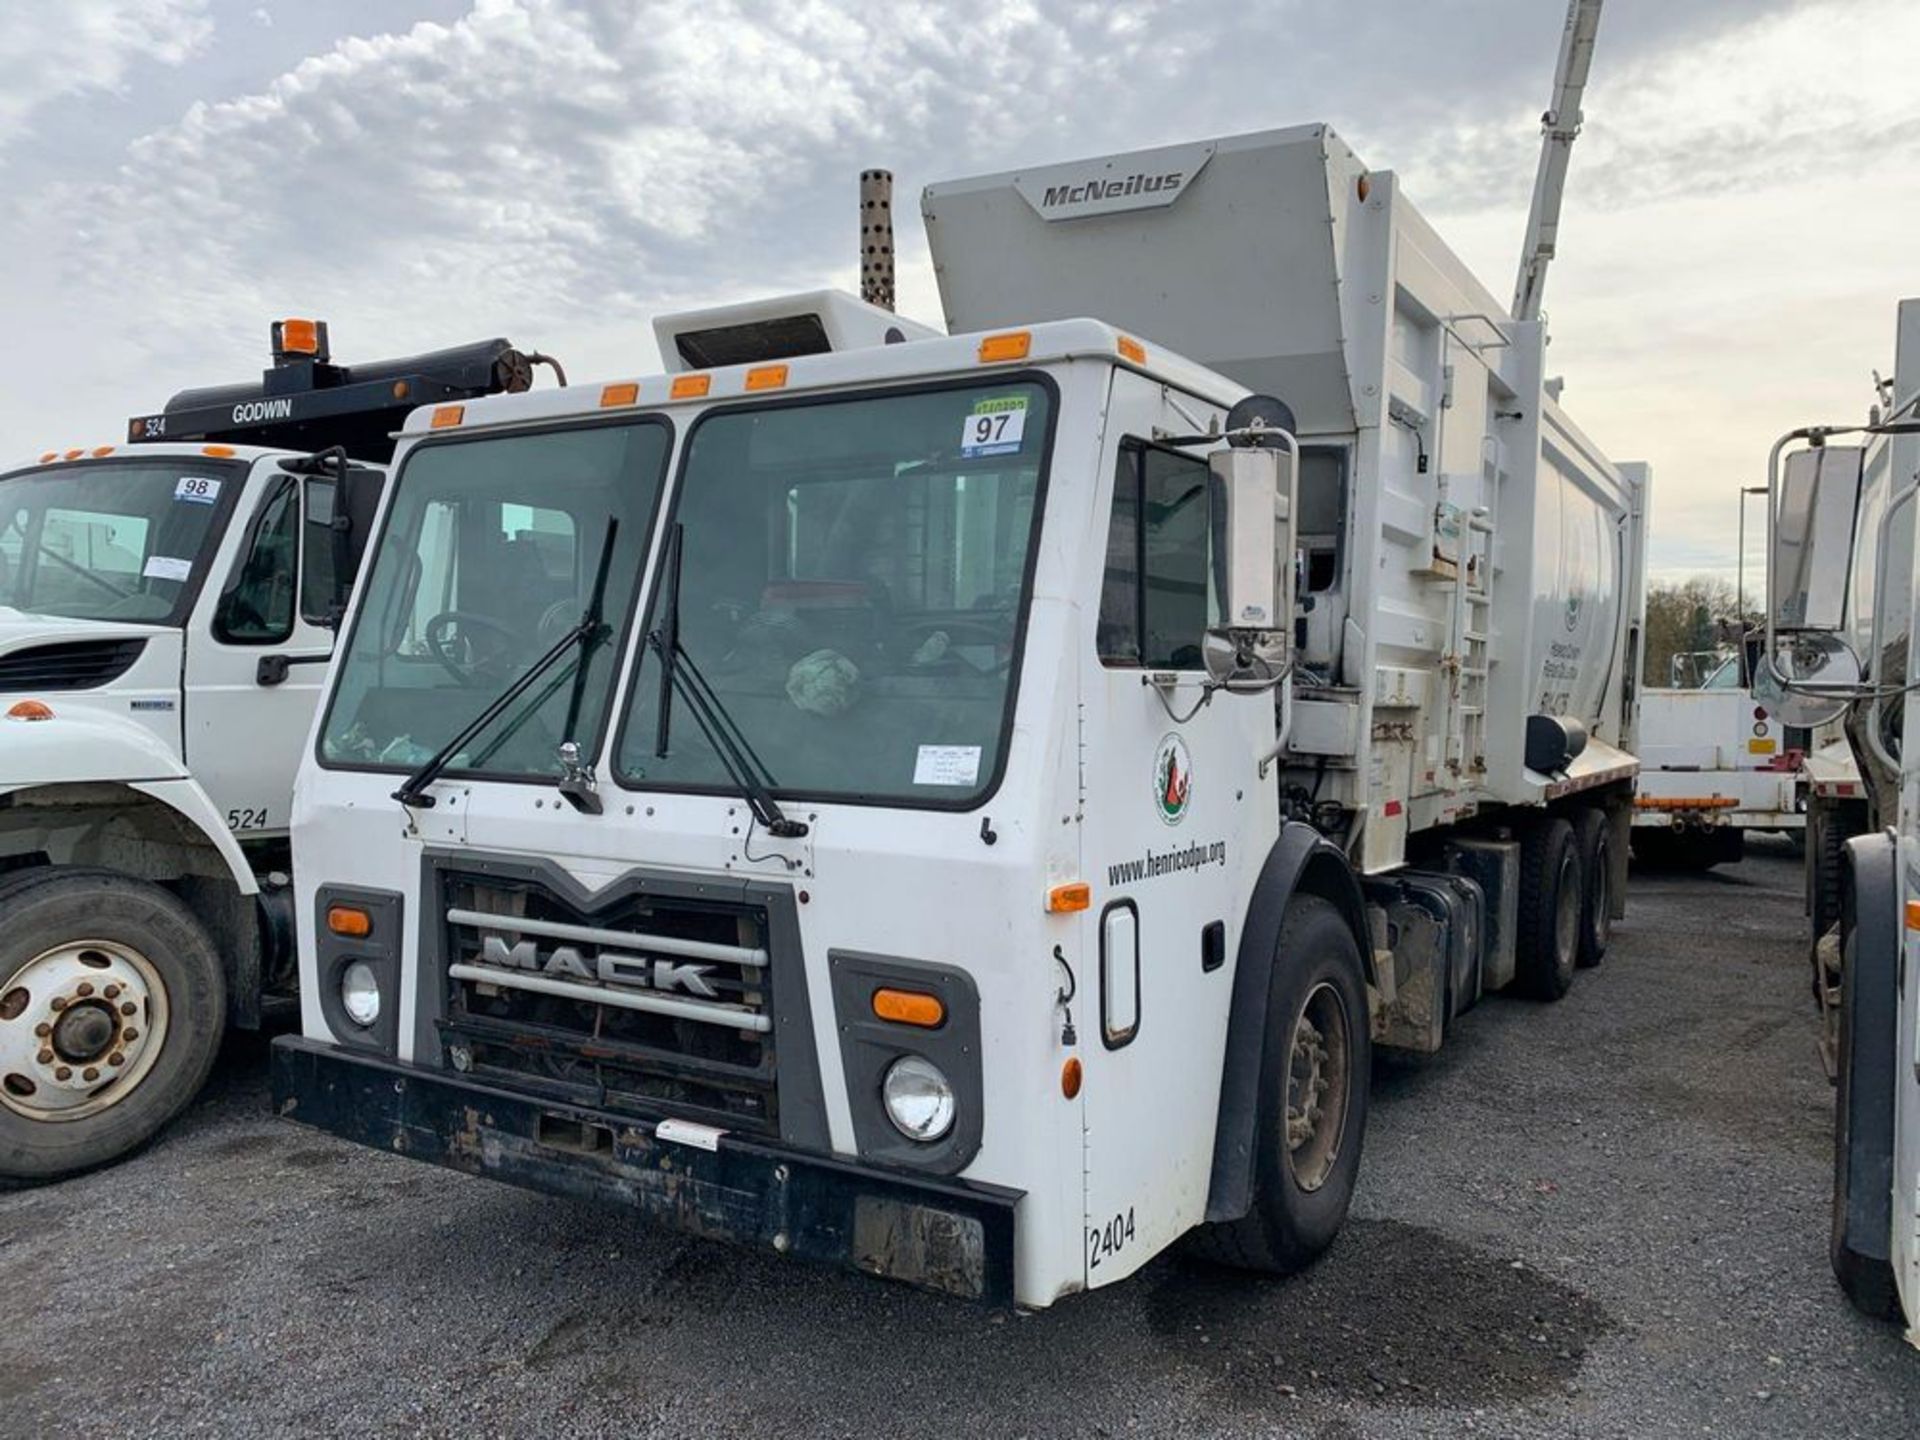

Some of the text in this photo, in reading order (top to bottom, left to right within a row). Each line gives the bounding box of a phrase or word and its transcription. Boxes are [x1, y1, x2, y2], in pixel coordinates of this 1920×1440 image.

[1043, 172, 1182, 207] McNeilus
[232, 399, 292, 424] GODWIN
[145, 416, 166, 437] 524
[976, 414, 1010, 443] 97
[184, 479, 209, 494] 98
[228, 808, 267, 830] 524
[1108, 839, 1226, 886] www.henricodpu.org
[483, 937, 718, 998] MACK
[1090, 1206, 1135, 1269] 2404
